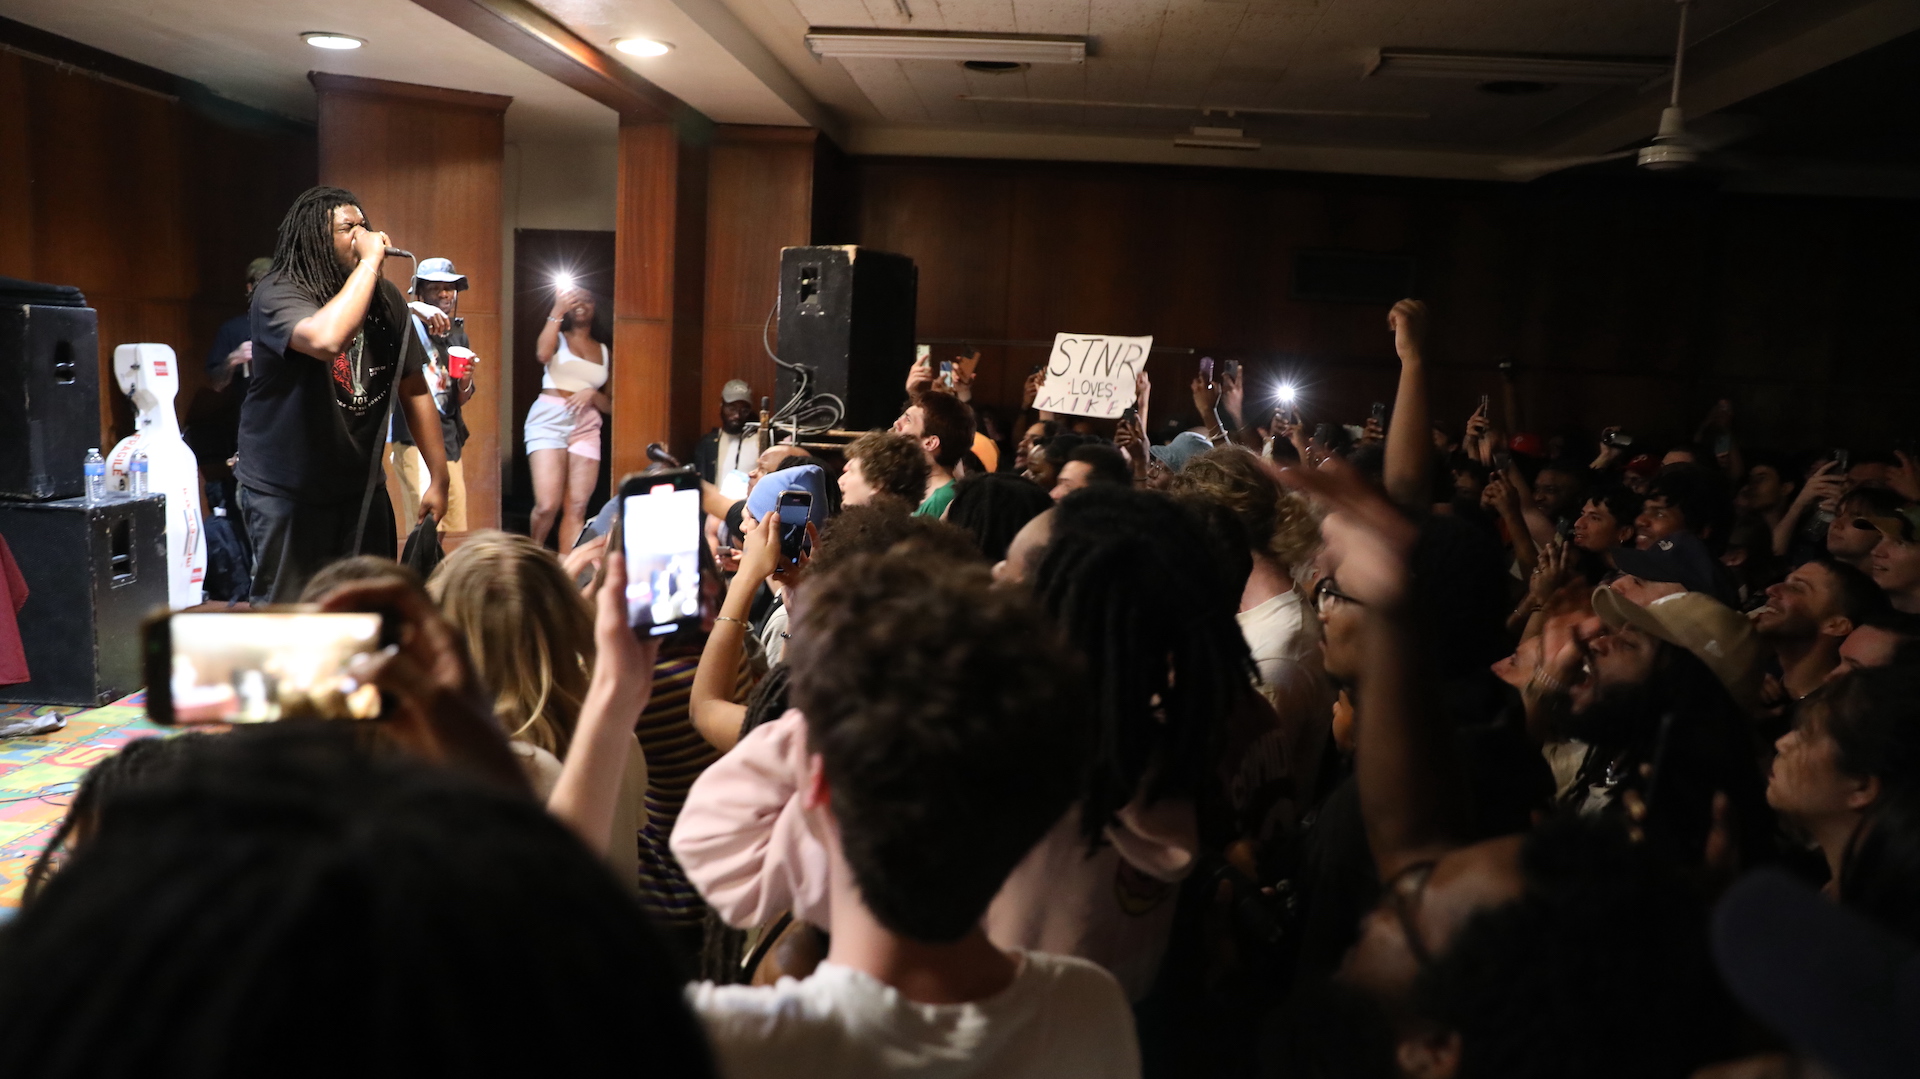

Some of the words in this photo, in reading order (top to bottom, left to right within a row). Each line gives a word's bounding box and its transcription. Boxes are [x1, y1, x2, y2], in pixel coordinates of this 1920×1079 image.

[1050, 338, 1143, 380] STNR
[1039, 396, 1118, 414] MIKE
[111, 434, 141, 476] FRAGILE
